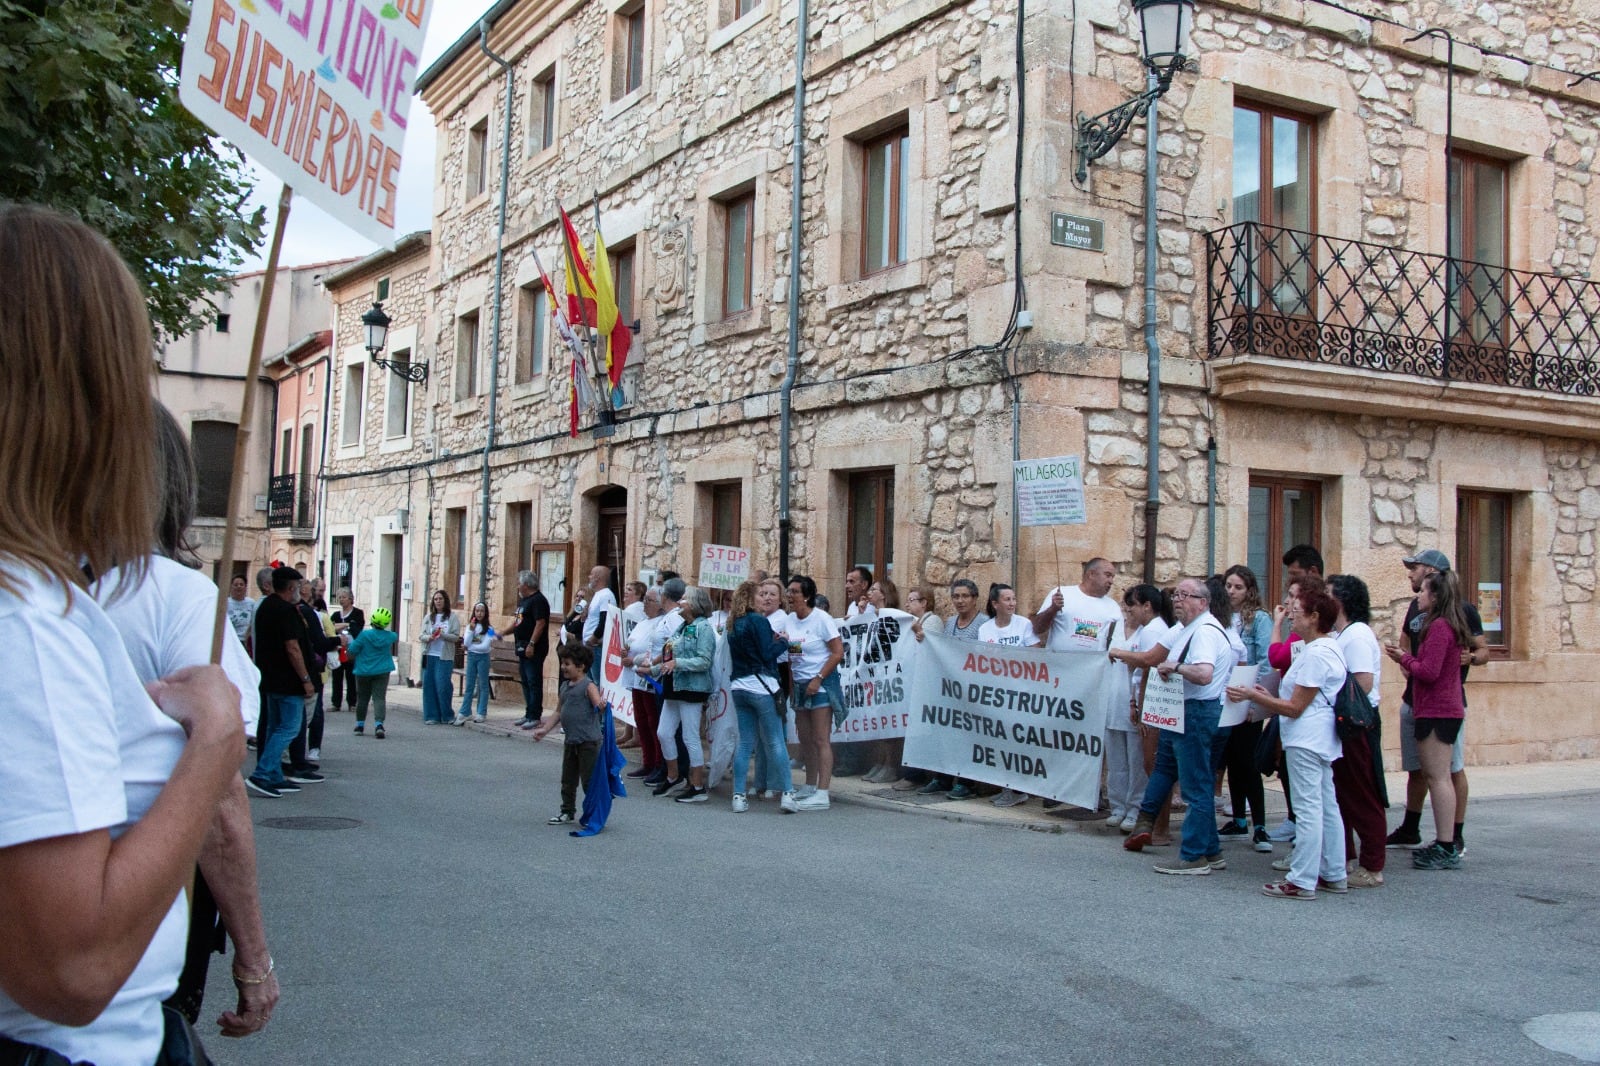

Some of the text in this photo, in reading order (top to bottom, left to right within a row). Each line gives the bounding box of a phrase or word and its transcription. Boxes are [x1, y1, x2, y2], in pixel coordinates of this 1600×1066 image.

[1066, 220, 1090, 232] Plaza
[1064, 231, 1092, 244] Mayor
[705, 546, 747, 562] STOP
[712, 561, 741, 574] A LA
[998, 635, 1020, 647] STOP
[962, 652, 1060, 689] ACCIONA,
[941, 677, 1086, 722] NO DESTRUYAS
[921, 704, 1103, 758] NUESTRA CALIDAD
[972, 743, 1049, 779] DE VIDA
